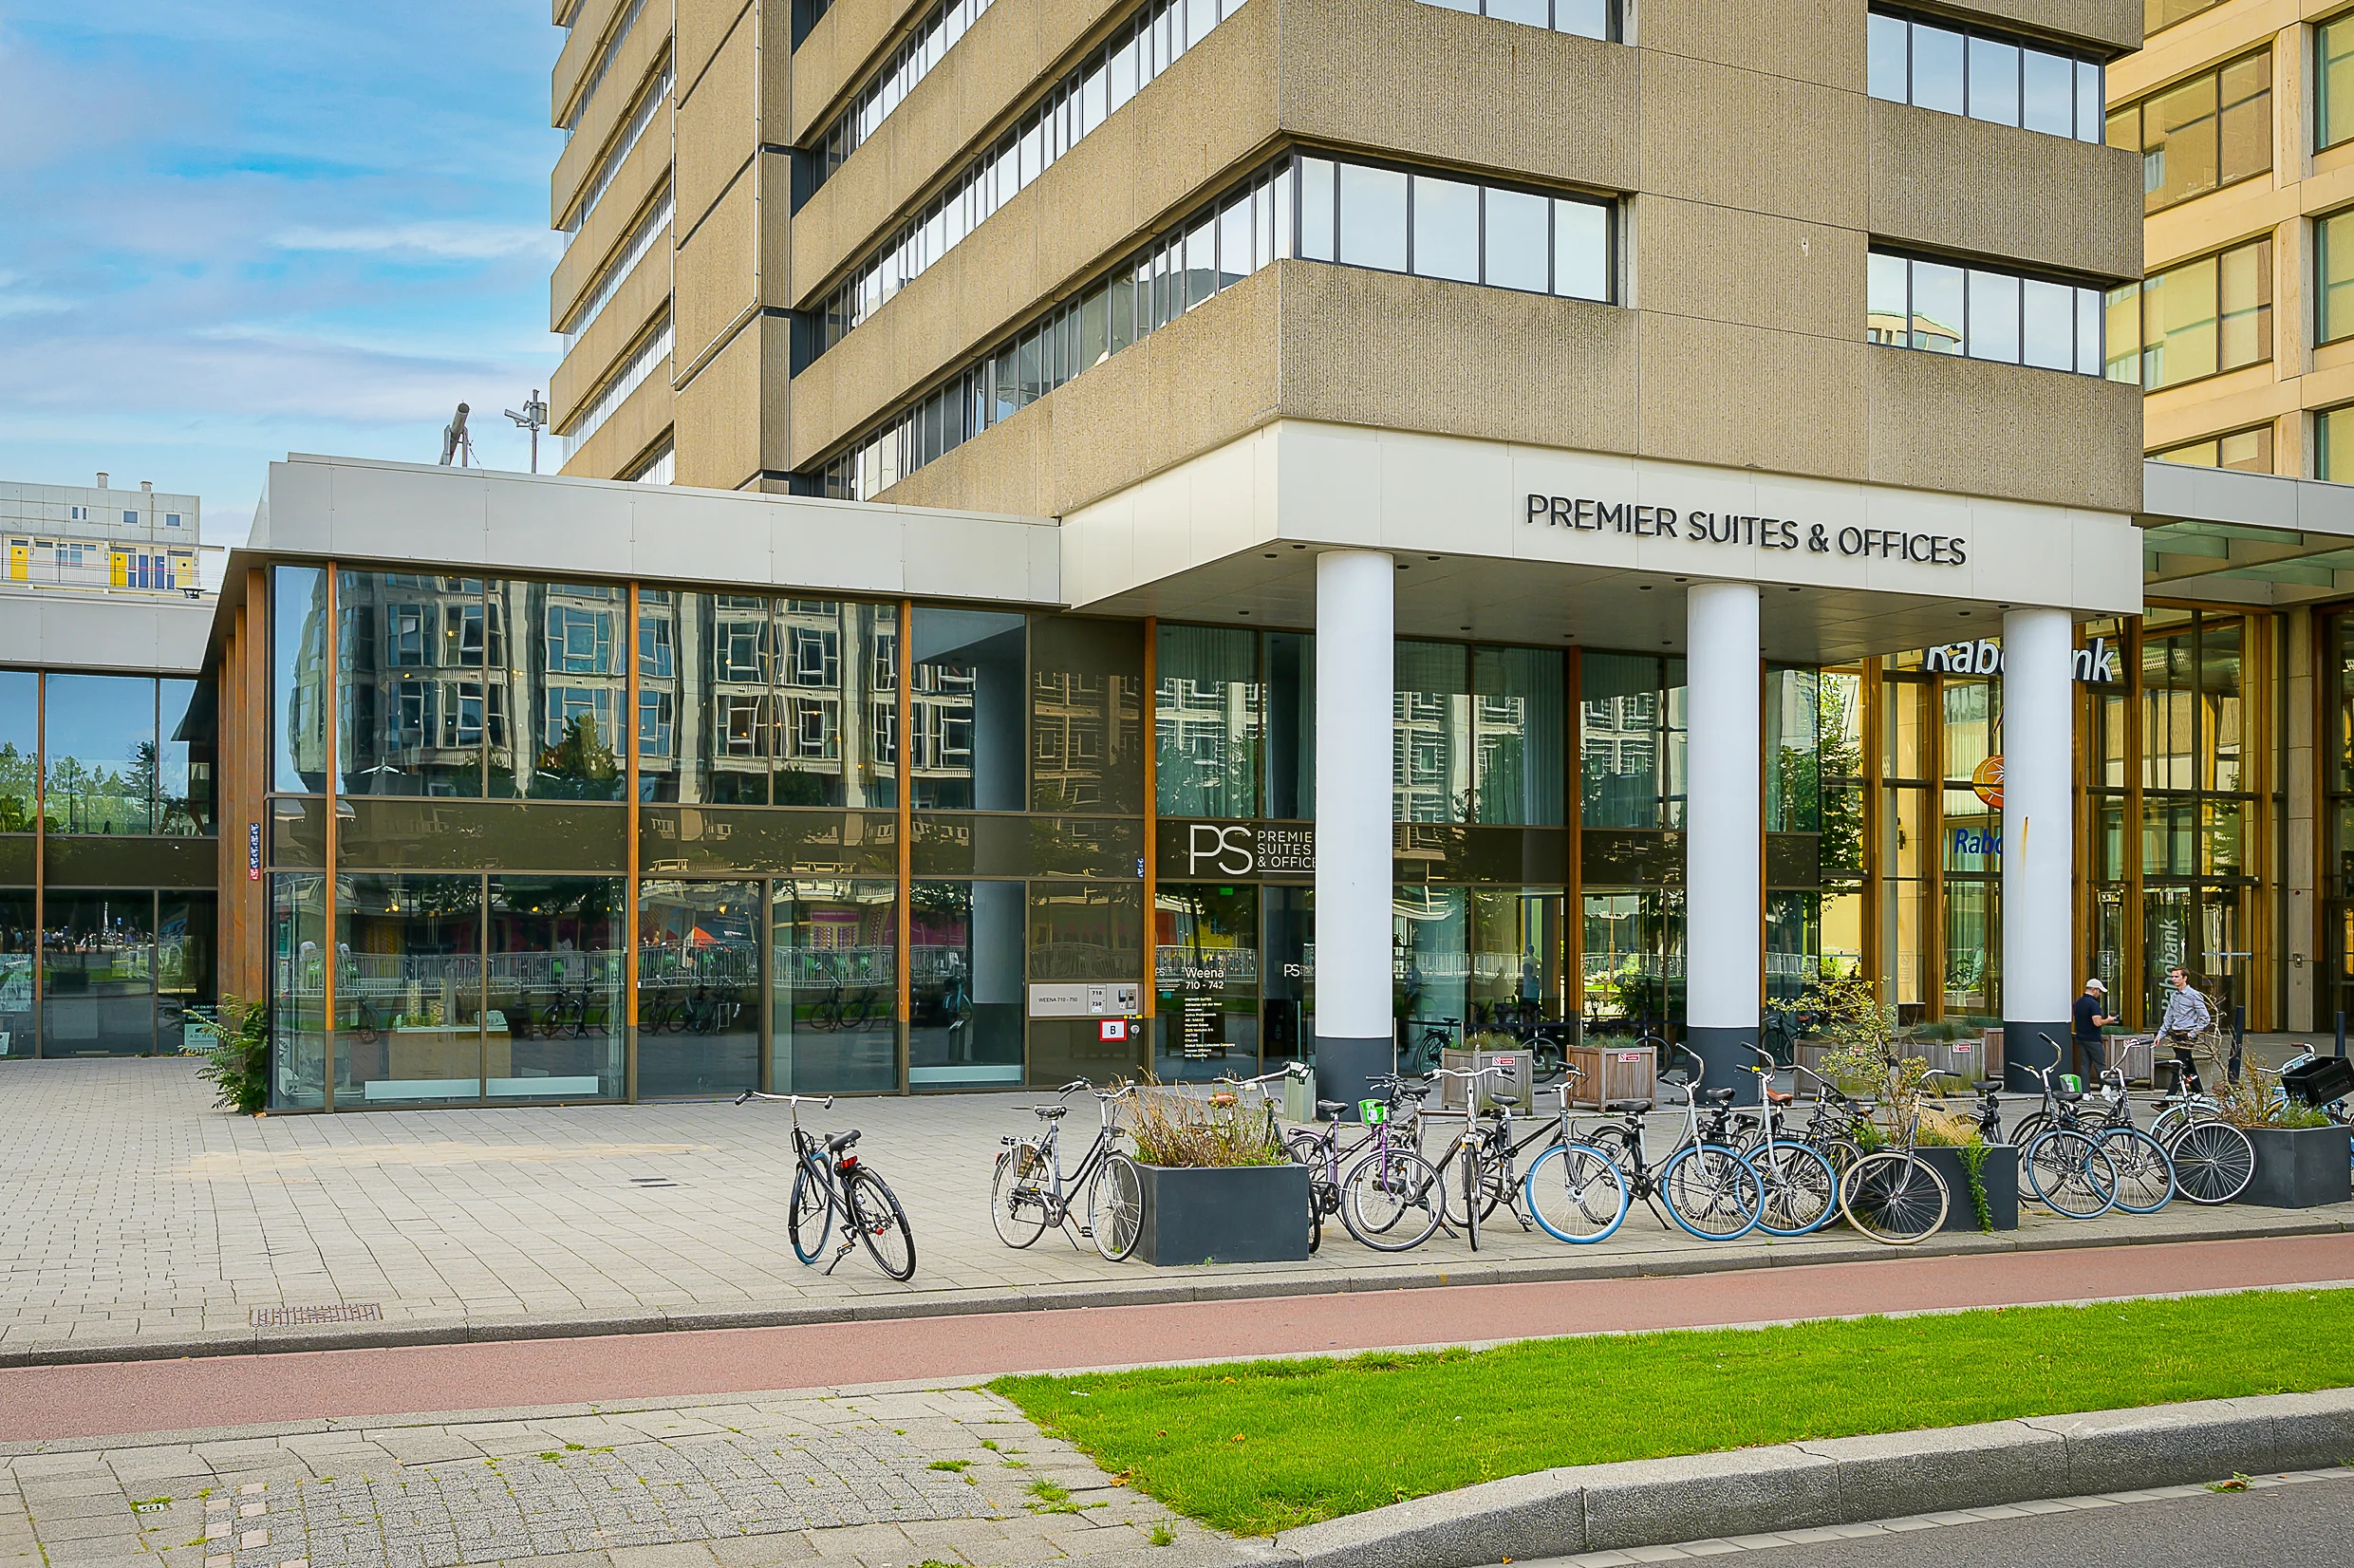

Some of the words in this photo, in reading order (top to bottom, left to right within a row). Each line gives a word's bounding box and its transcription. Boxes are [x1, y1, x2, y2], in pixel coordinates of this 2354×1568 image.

[1526, 494, 1678, 538] PREMIER
[1688, 511, 1799, 550] SUITES
[1808, 523, 1830, 552] &
[1838, 526, 1967, 566] OFFICES
[1258, 831, 1313, 843] PREMIE
[1954, 828, 2004, 854] Rabo
[1189, 824, 1253, 875] PS
[1258, 843, 1312, 855] SUITES
[1258, 855, 1266, 868] &
[1271, 856, 1316, 868] OFFIC
[1185, 967, 1224, 978] Weena
[1284, 963, 1300, 977] PS
[1208, 980, 1224, 989] 742
[1110, 1025, 1116, 1035] B
